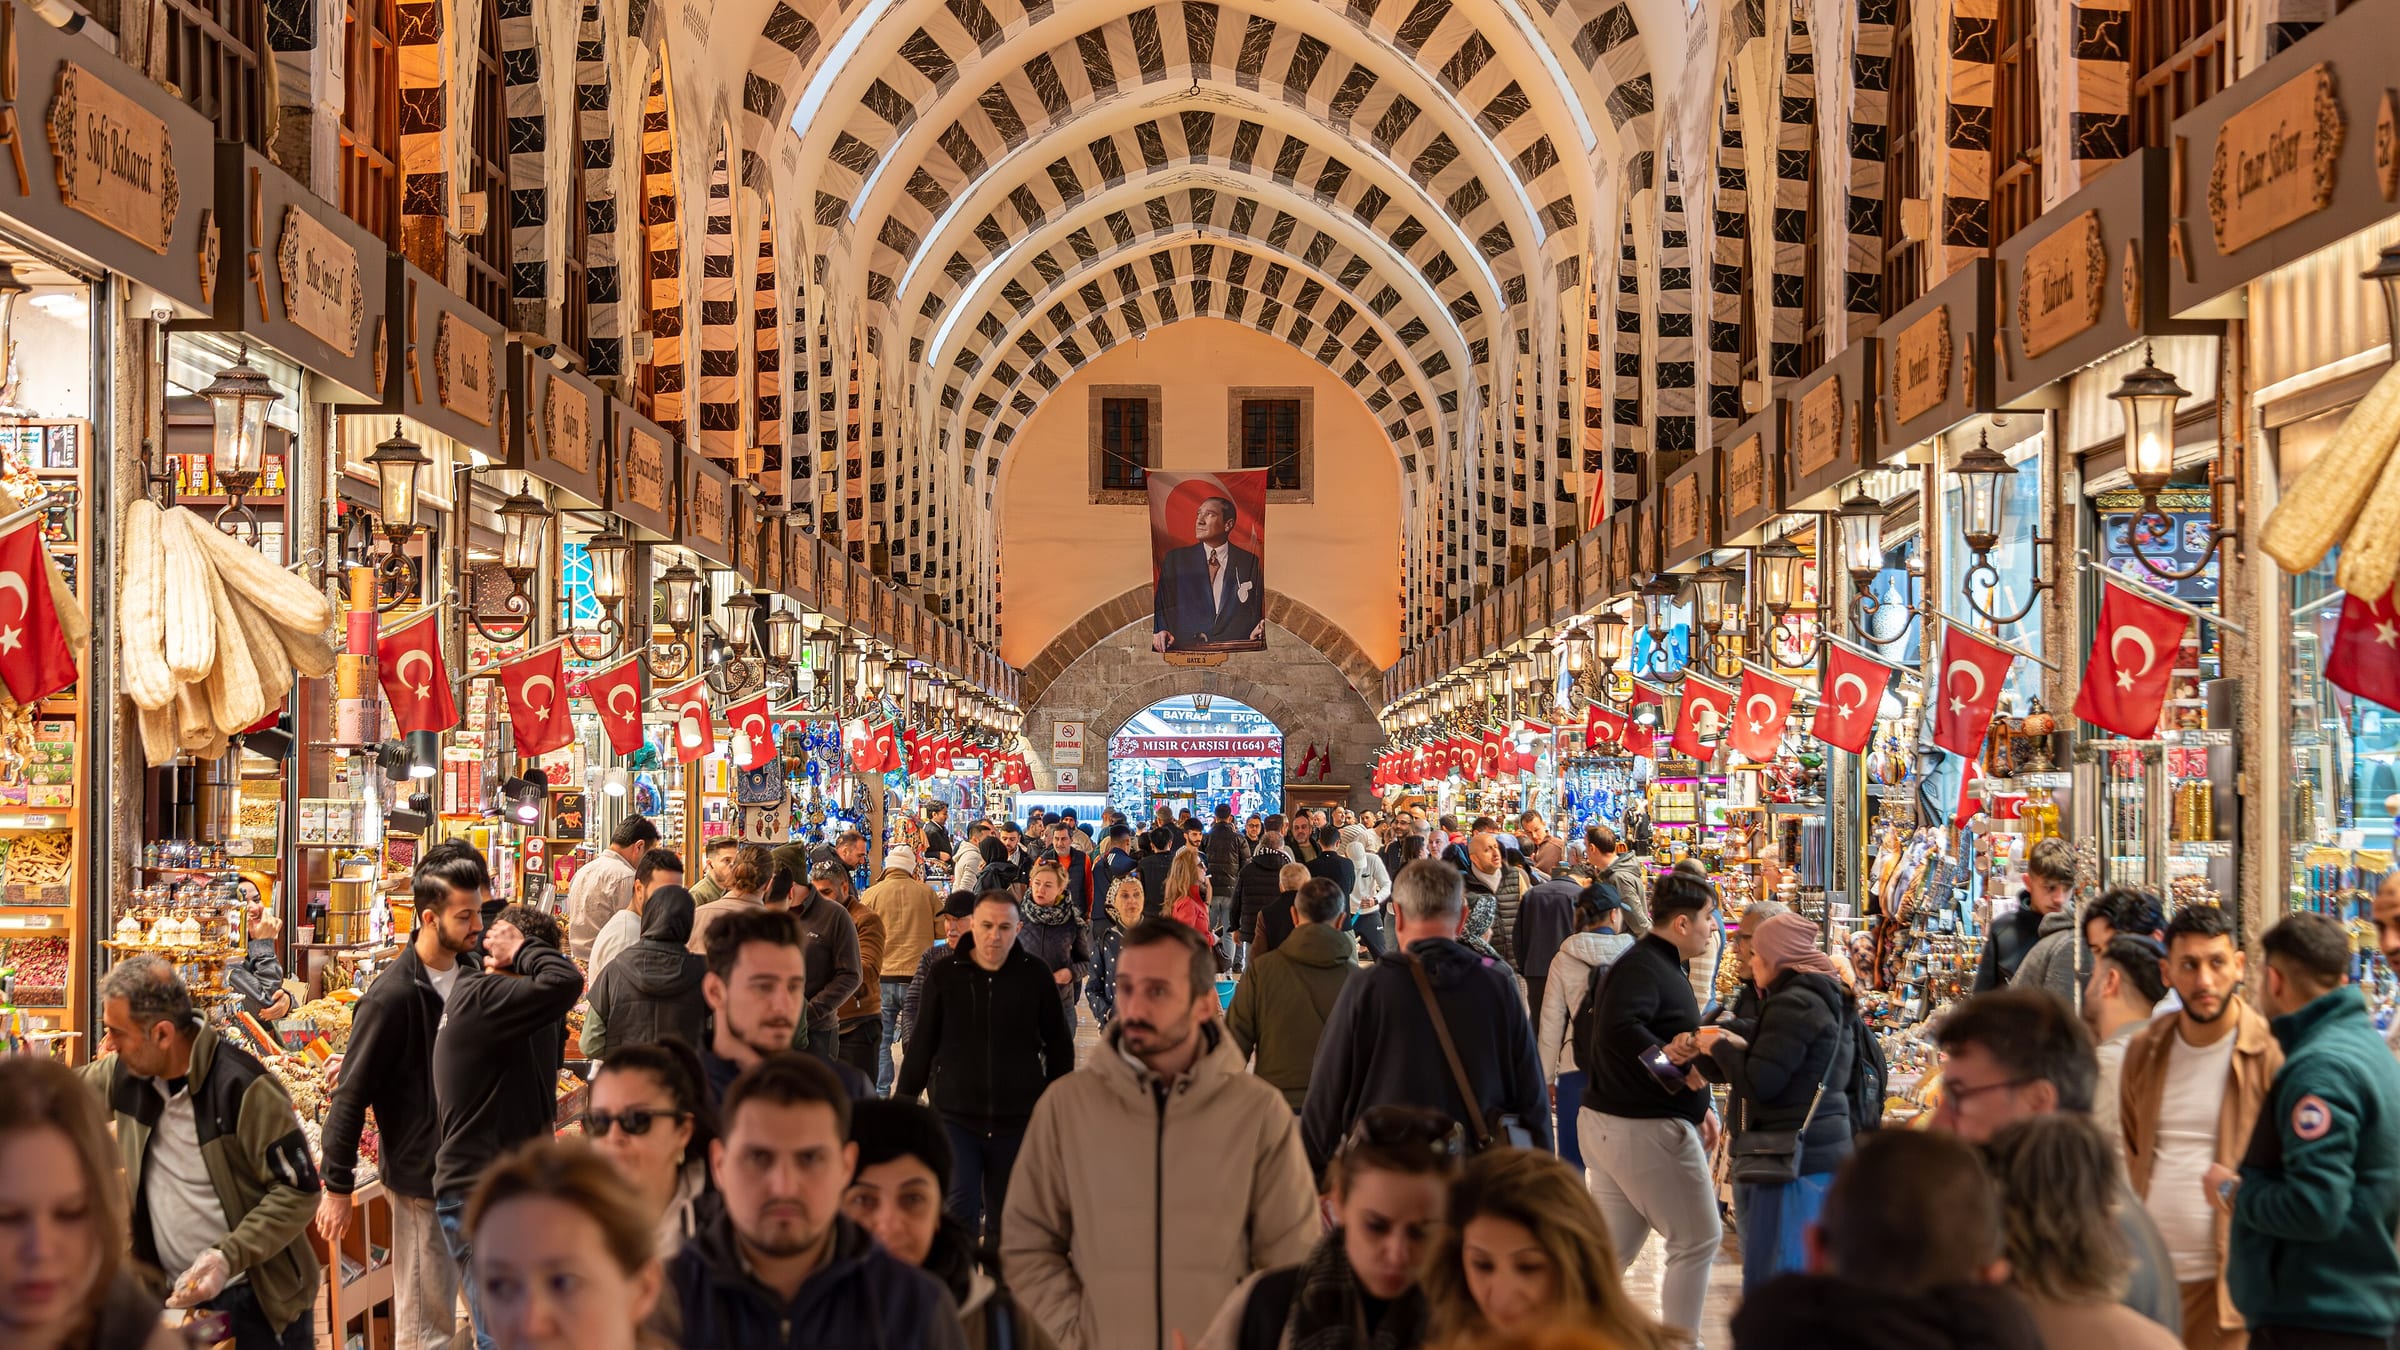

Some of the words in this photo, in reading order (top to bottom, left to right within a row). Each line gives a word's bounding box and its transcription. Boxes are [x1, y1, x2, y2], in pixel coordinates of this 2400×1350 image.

[87, 113, 108, 185] Sufi
[110, 128, 152, 194] Baharat
[207, 237, 216, 276] 45
[306, 247, 321, 292] Blue
[321, 259, 345, 310] Special
[1163, 711, 1211, 721] BAYRAM
[1143, 742, 1178, 750] MISIR
[1181, 741, 1229, 752] ÇARŞISI
[1232, 741, 1265, 751] (1664)
